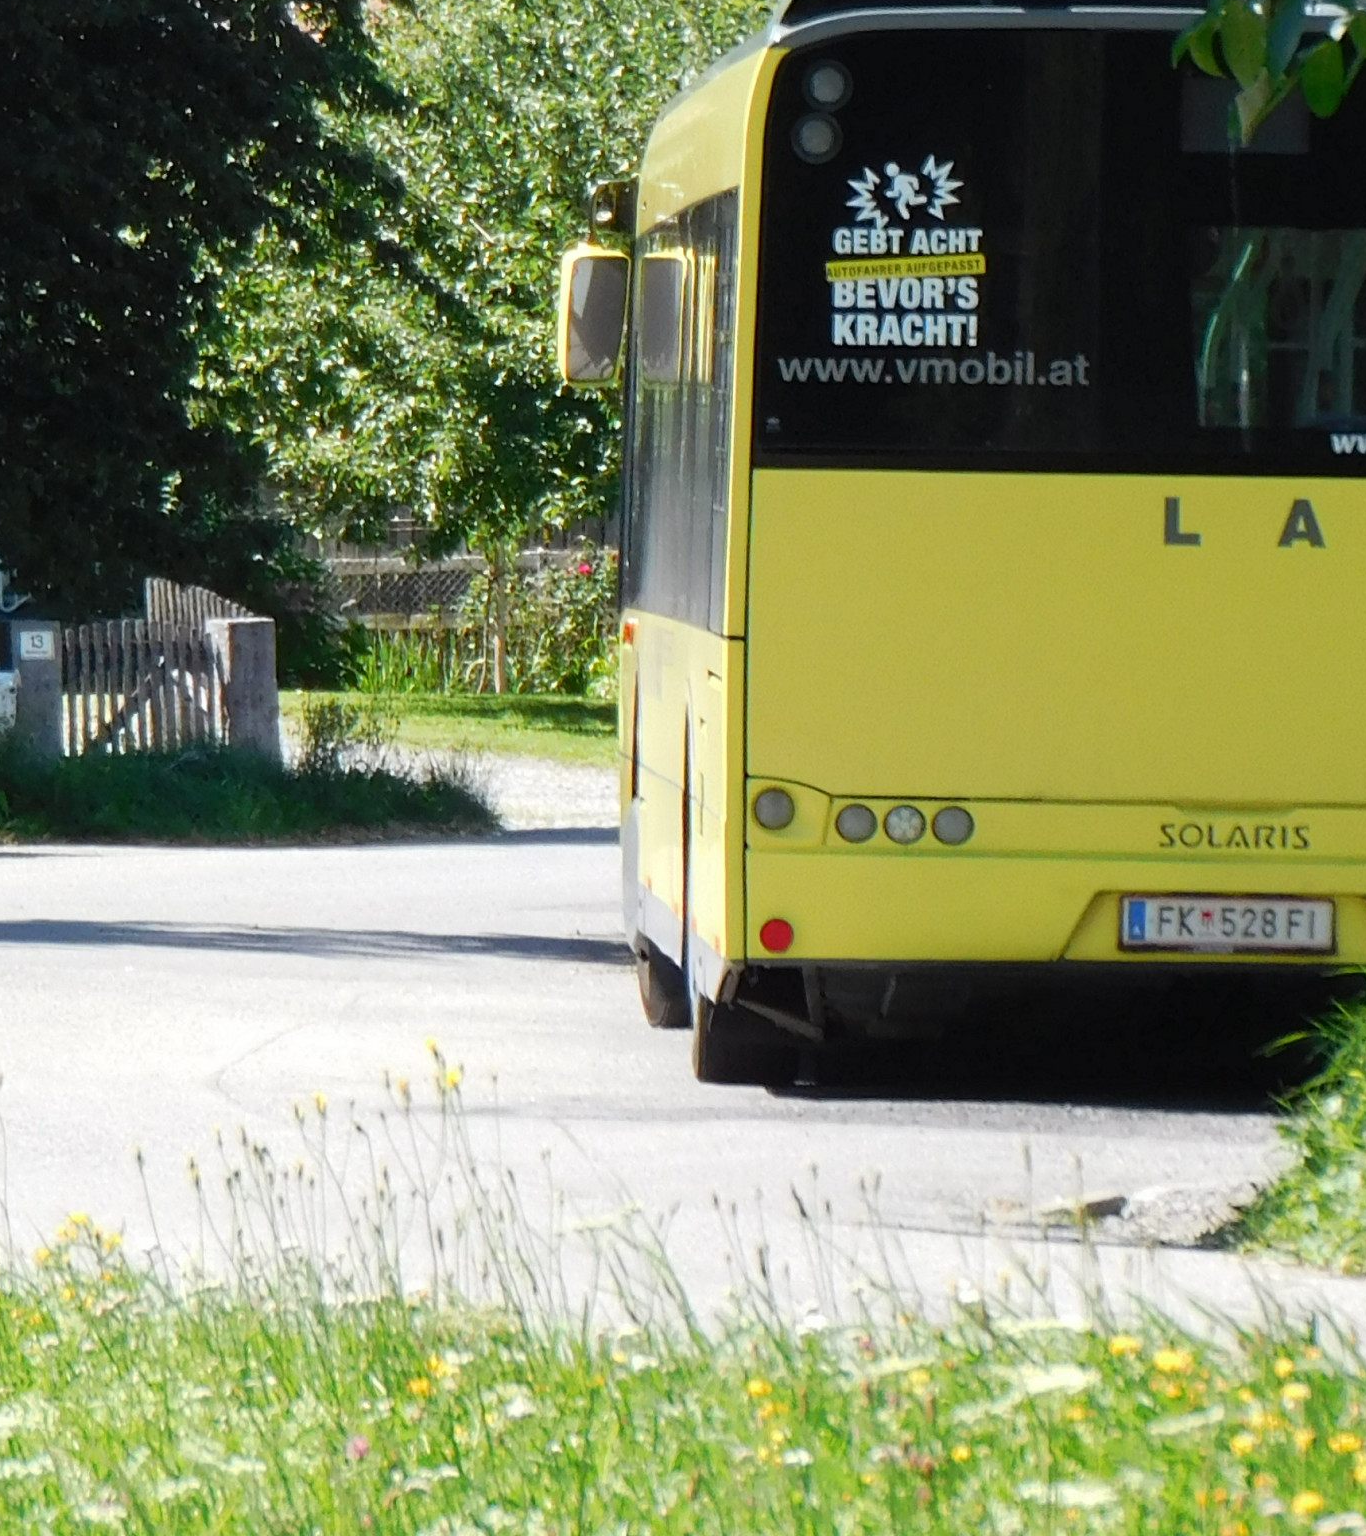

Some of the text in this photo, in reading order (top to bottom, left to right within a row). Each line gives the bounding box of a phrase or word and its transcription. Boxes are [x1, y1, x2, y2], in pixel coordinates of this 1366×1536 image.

[834, 228, 983, 255] GEBT ACHT
[906, 259, 981, 274] AUFGEPASST
[832, 313, 977, 346] KRACHT!
[777, 351, 1090, 387] www.vmobil.at
[31, 634, 44, 649] 13
[1159, 823, 1310, 850] SOLARIS
[1157, 906, 1196, 938] FK
